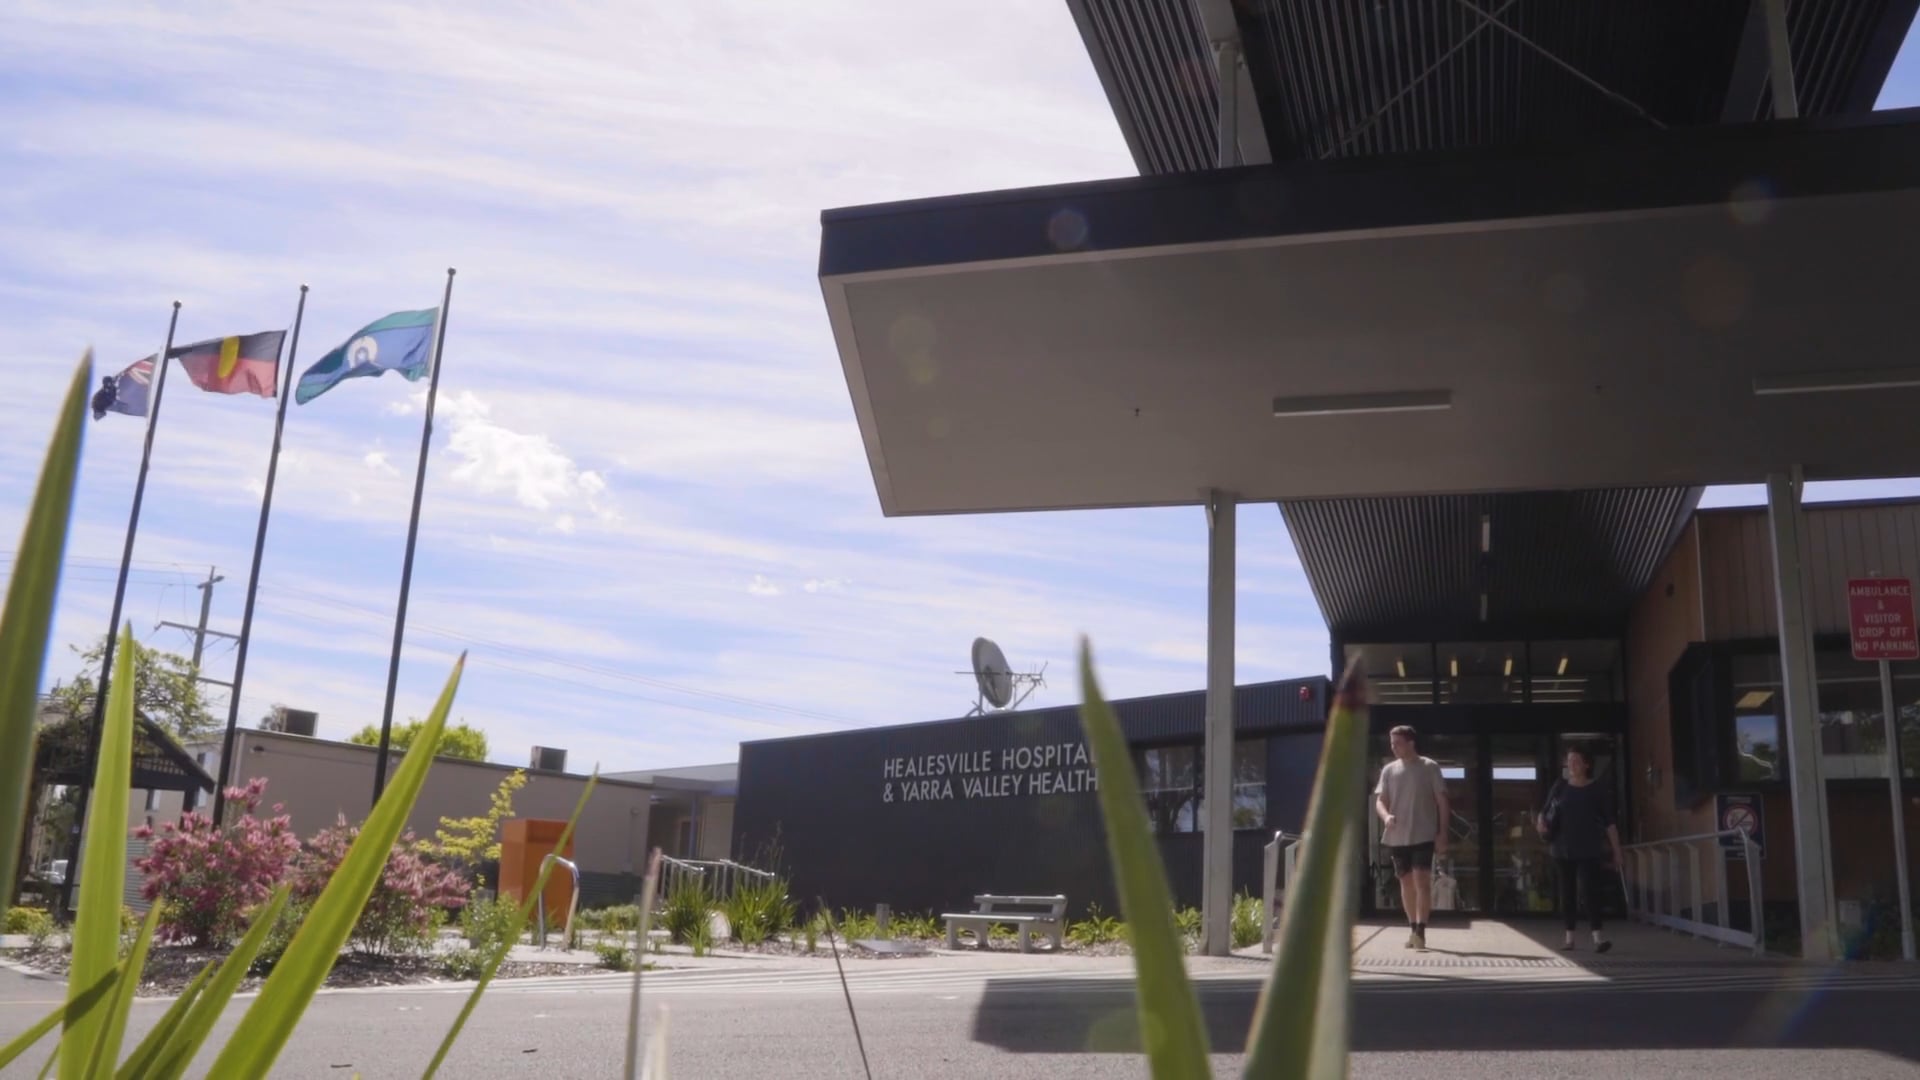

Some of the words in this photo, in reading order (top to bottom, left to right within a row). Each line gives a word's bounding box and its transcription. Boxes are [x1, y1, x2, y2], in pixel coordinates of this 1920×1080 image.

[1850, 585, 1910, 596] AMBULANCE
[1863, 613, 1902, 623] VISITOR
[1858, 627, 1885, 638] DROP
[1889, 626, 1908, 637] OFF
[1854, 641, 1869, 651] NO
[1872, 640, 1916, 651] PARKING
[883, 750, 992, 779] HEALESVILLE
[883, 782, 894, 803] &
[901, 779, 954, 802] YARRA
[962, 774, 1023, 799] VALLEY
[1029, 767, 1099, 795] HEALTH
